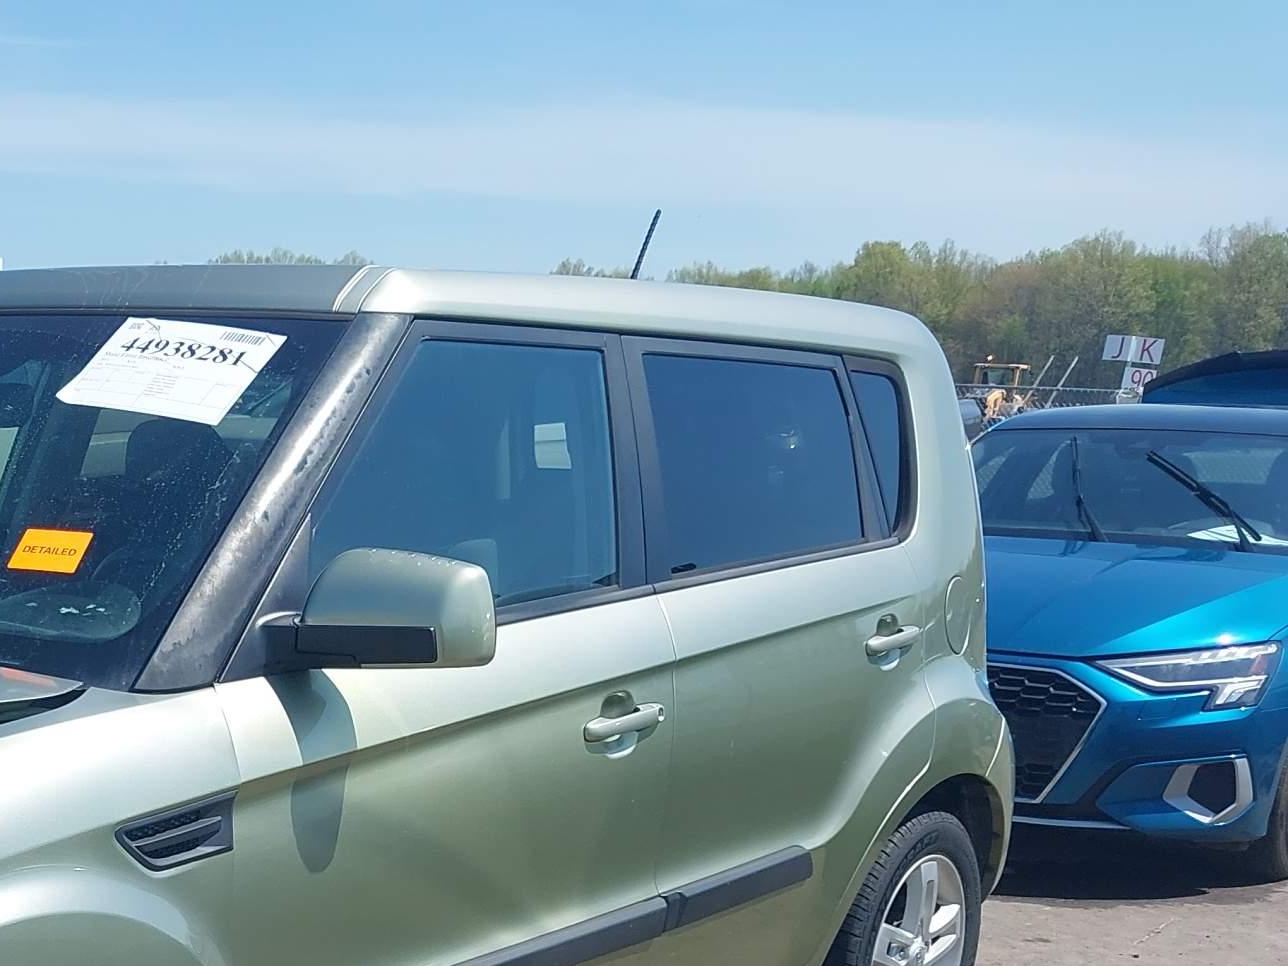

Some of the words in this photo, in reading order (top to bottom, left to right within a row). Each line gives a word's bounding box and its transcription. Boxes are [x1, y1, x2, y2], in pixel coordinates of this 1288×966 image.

[120, 336, 247, 367] 44938281
[1111, 337, 1125, 359] J
[1140, 339, 1158, 362] K
[22, 545, 78, 557] DETAILED
